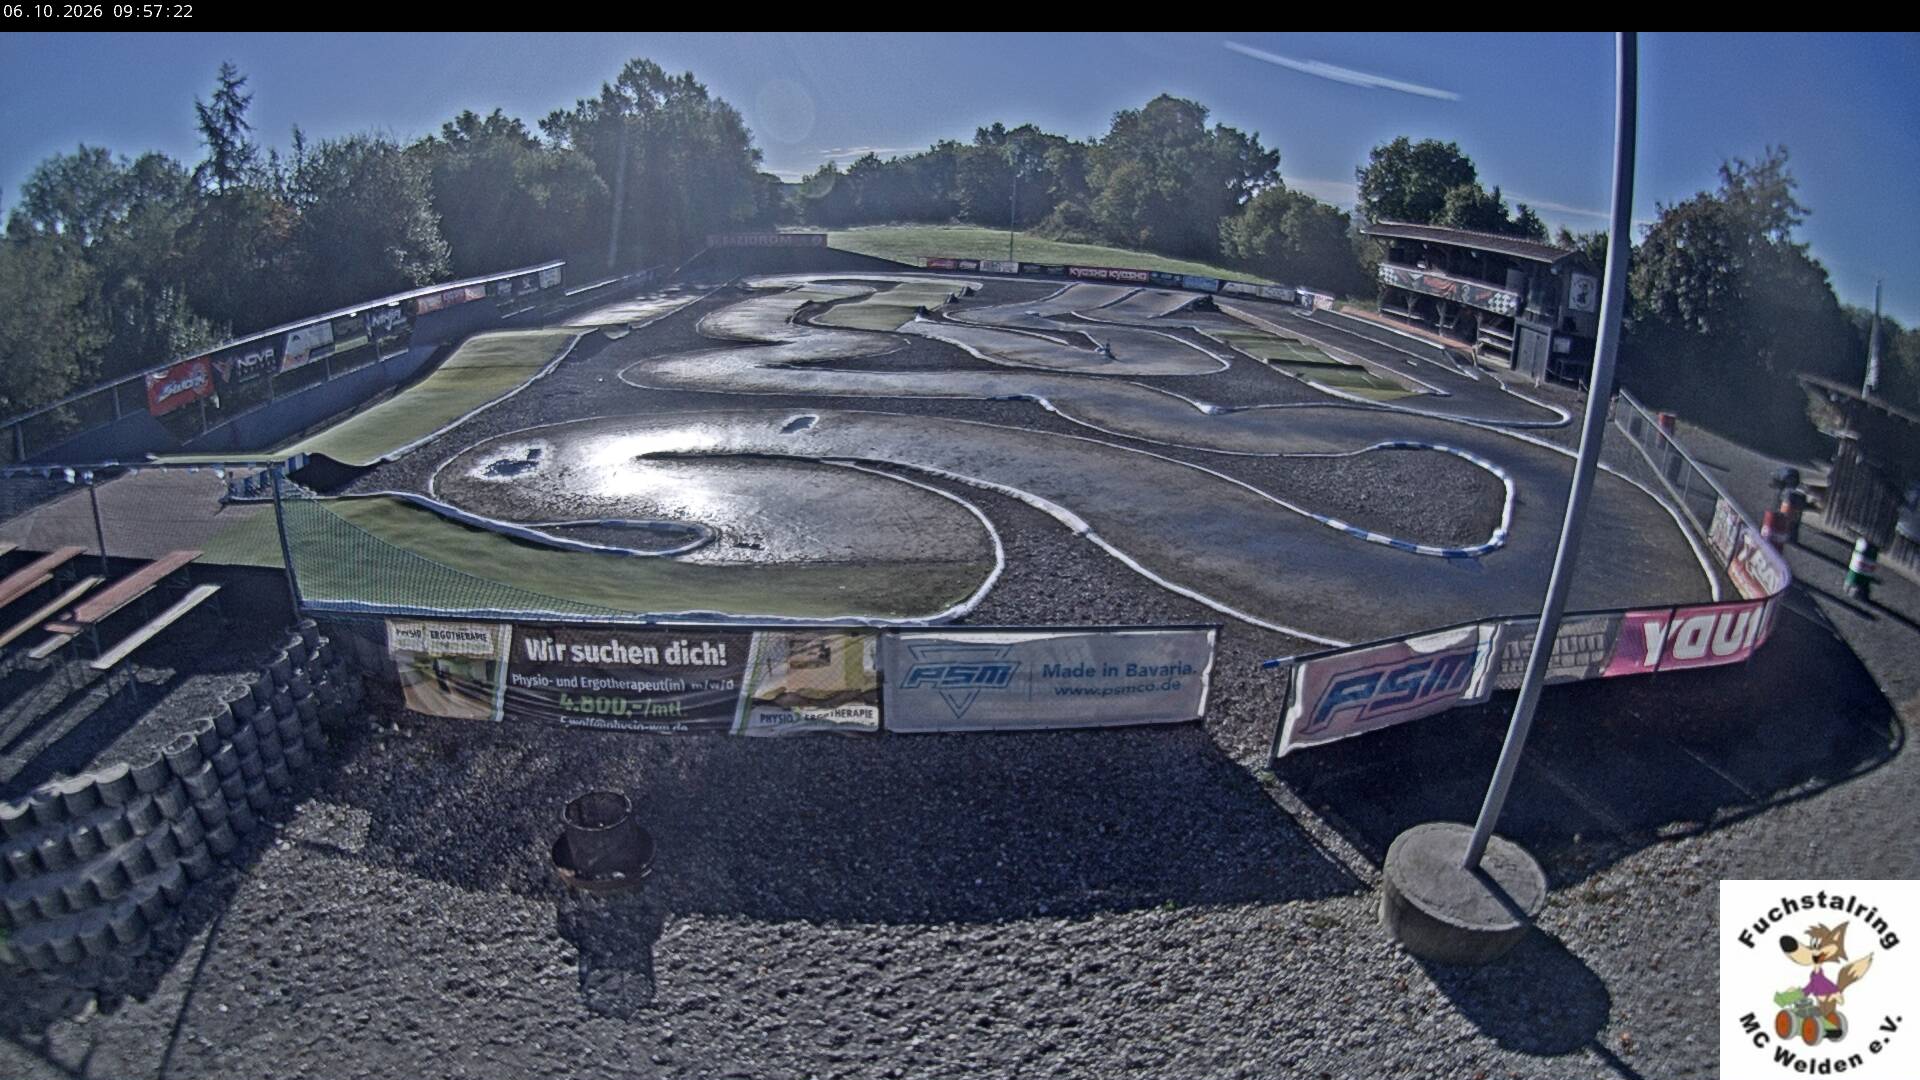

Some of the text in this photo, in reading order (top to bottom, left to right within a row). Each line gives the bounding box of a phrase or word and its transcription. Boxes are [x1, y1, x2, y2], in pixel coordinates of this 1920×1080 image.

[237, 347, 275, 368] NOVA
[525, 637, 727, 666] Wir suchen dich!
[903, 663, 1016, 688] PSM
[1042, 661, 1198, 679] Made in Bavaria.
[512, 673, 554, 689] Physio-
[556, 675, 578, 688] und
[581, 675, 685, 692] Ergotherapeut(in)
[1054, 678, 1182, 698] www.psmco.de
[760, 712, 793, 724] PHYSIO
